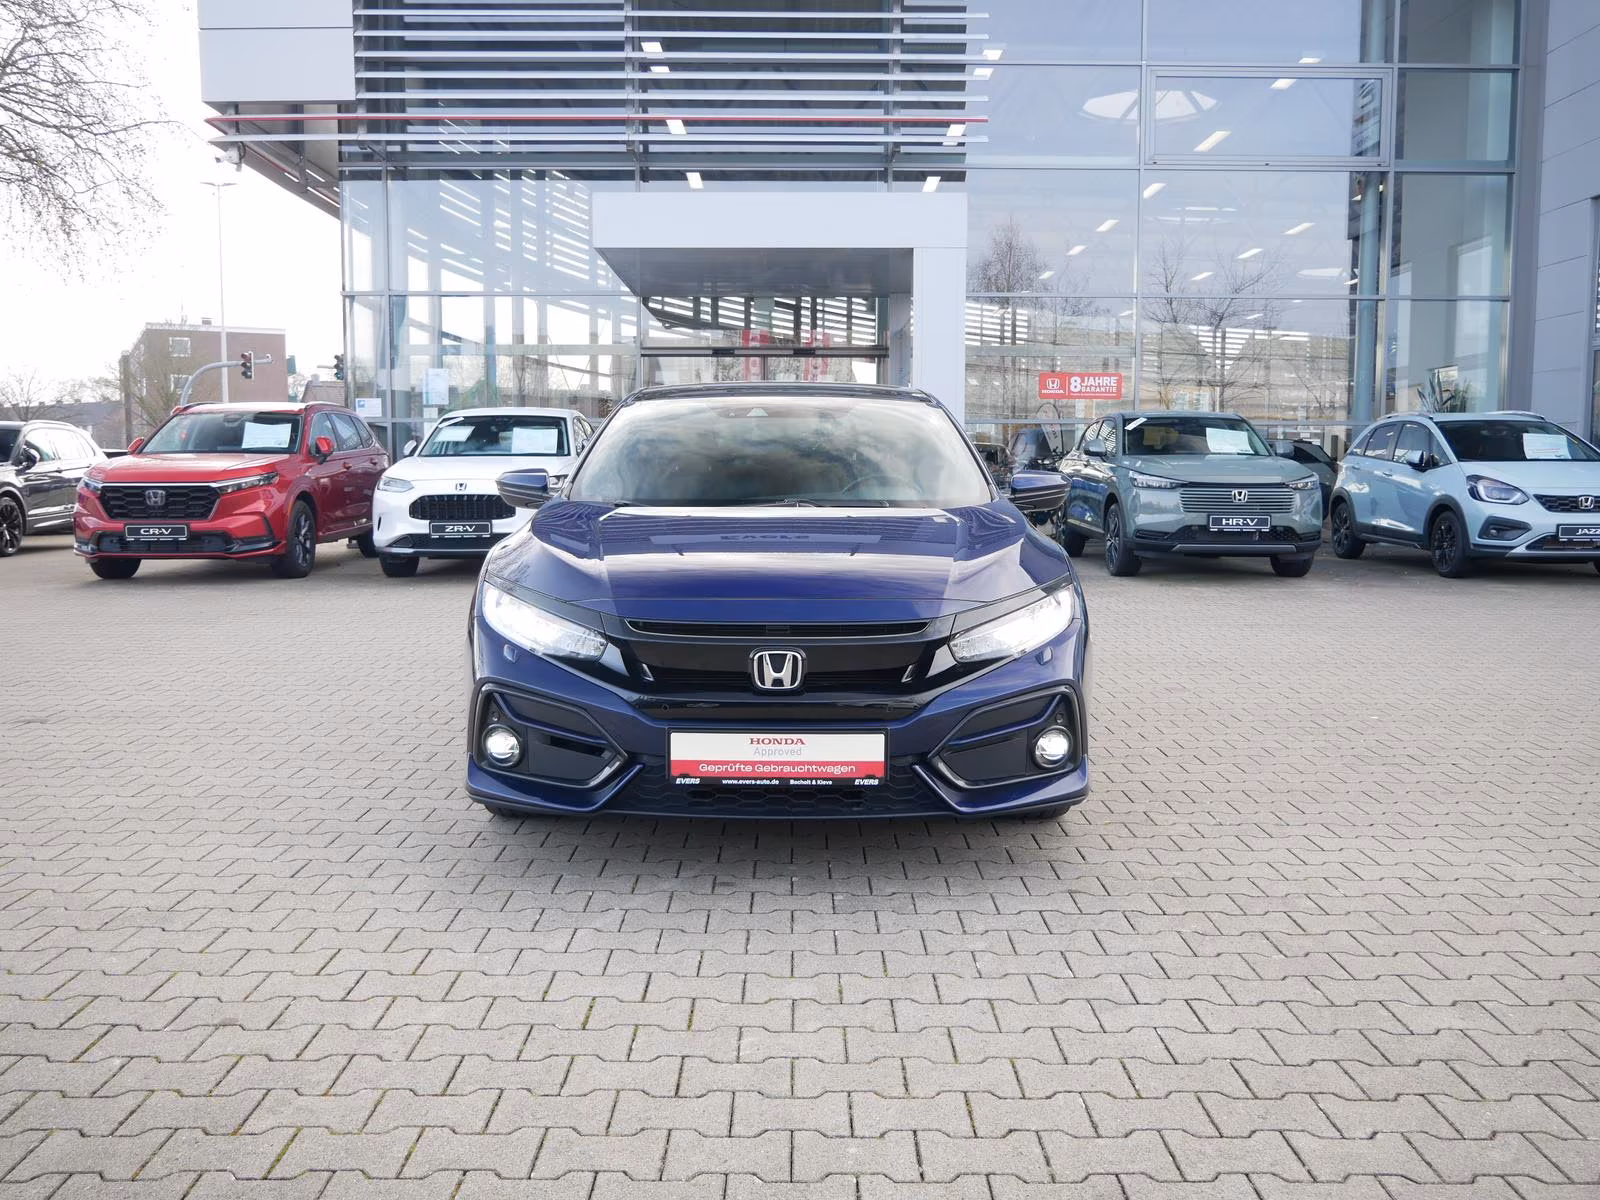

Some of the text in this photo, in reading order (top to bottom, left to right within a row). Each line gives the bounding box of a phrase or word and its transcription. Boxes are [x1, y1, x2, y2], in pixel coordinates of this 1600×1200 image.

[1070, 376, 1118, 392] 8 JAHRE
[1222, 518, 1258, 526] HR-V
[749, 737, 806, 746] HONDA
[753, 746, 803, 757] Approved
[699, 762, 856, 775] Geprüfte Gebrauchtwagen
